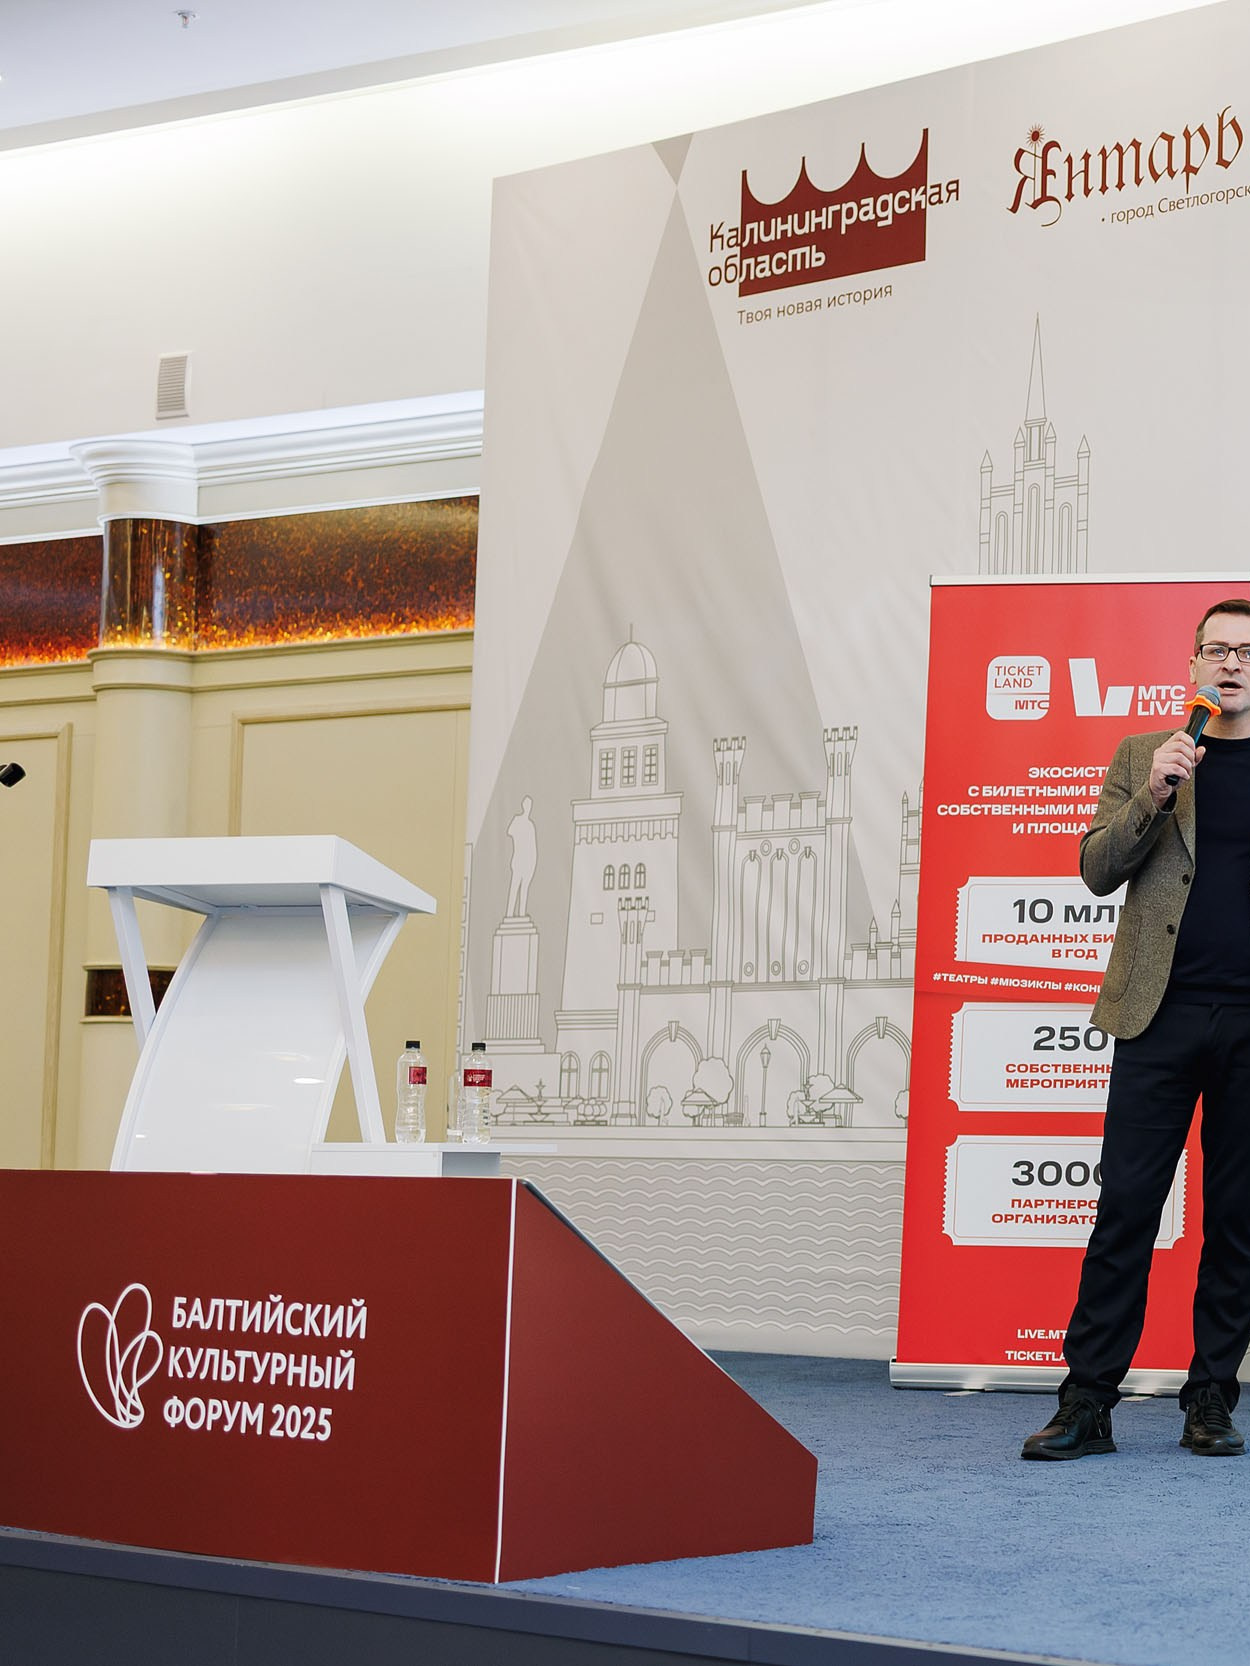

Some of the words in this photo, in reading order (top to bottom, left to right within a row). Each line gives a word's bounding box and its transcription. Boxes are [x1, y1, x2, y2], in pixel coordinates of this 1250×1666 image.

[710, 179, 960, 253] Калининградская
[1111, 204, 1154, 224] город
[708, 244, 826, 287] область
[737, 306, 772, 325] Твоя
[777, 298, 822, 318] новая
[827, 285, 893, 309] история
[994, 665, 1044, 676] TICKET
[994, 678, 1033, 688] LAND
[1137, 701, 1185, 716] LIVE
[1028, 767, 1109, 778] ЭКОСИСТ
[968, 786, 979, 797] С
[982, 785, 1087, 797] БИЛЕТНЫМИ
[1090, 786, 1104, 797] В
[937, 804, 1074, 816] СОБСТВЕННЫМИ
[1012, 823, 1024, 834] И
[1027, 822, 1091, 836] ПЛОЩА
[1012, 899, 1054, 923] 10
[1064, 904, 1124, 923] мл
[981, 933, 1089, 945] ПРОДАННЫХ
[1052, 949, 1061, 958] В
[1065, 949, 1098, 960] ГОД
[933, 973, 988, 985] #ТЕАТРЫ
[990, 977, 1061, 990] #МЮЗИКЛЫ
[1033, 1026, 1109, 1051] 250
[1005, 1079, 1109, 1089] МЕРОПРИЯТ
[1011, 1199, 1098, 1209] ПАРТНЕРО
[171, 1294, 368, 1339] БАЛТИЙСКИЙ
[167, 1346, 356, 1391] КУЛЬТУРНЫЙ
[163, 1395, 265, 1435] ФОРУМ
[269, 1404, 333, 1441] 2025
